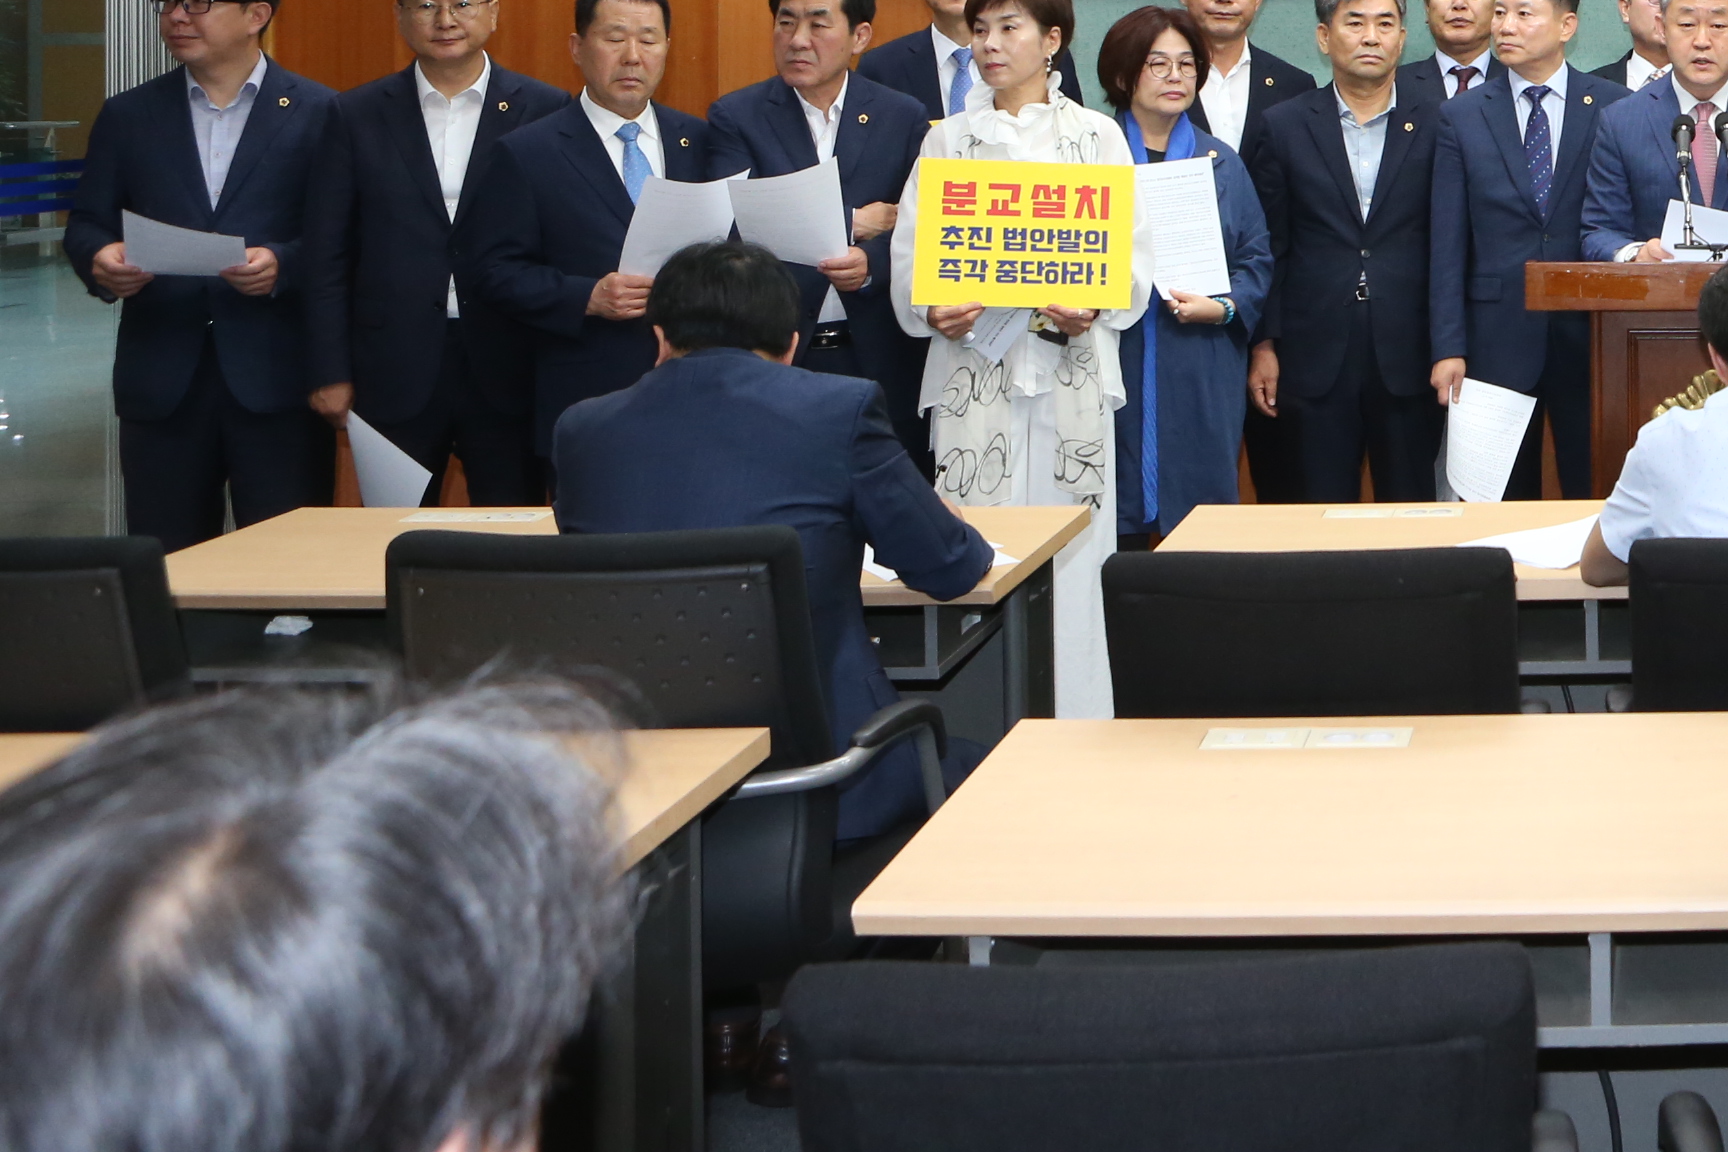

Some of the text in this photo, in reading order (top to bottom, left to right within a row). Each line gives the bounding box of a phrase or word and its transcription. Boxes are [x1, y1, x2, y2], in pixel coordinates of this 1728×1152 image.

[941, 180, 1111, 221] 분교설치
[939, 225, 1109, 254] 추진 법안발의
[938, 258, 1108, 286] 즉각 중단하라!
